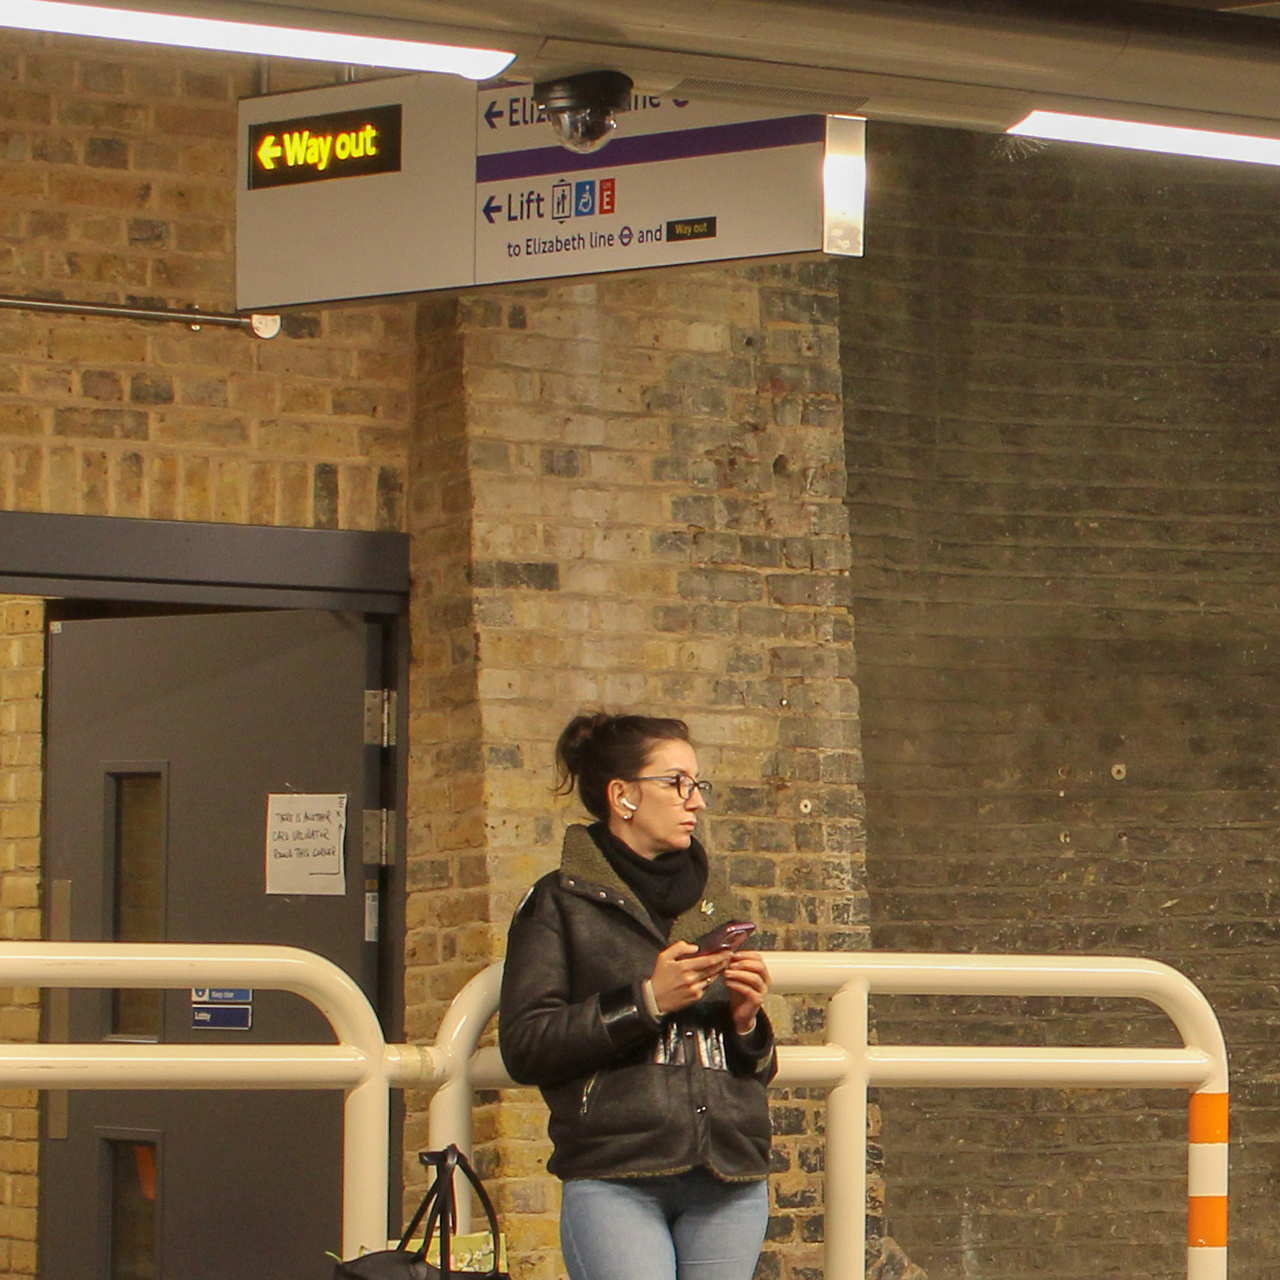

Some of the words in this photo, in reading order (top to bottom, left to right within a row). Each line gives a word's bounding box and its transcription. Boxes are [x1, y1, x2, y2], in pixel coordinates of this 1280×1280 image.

[283, 130, 333, 171] Way
[335, 124, 377, 160] out
[507, 190, 545, 222] Lift
[507, 242, 521, 257] to
[525, 234, 585, 255] Elizabeth
[589, 231, 614, 249] line
[637, 225, 662, 243] and
[674, 223, 692, 236] Way
[693, 220, 708, 233] out
